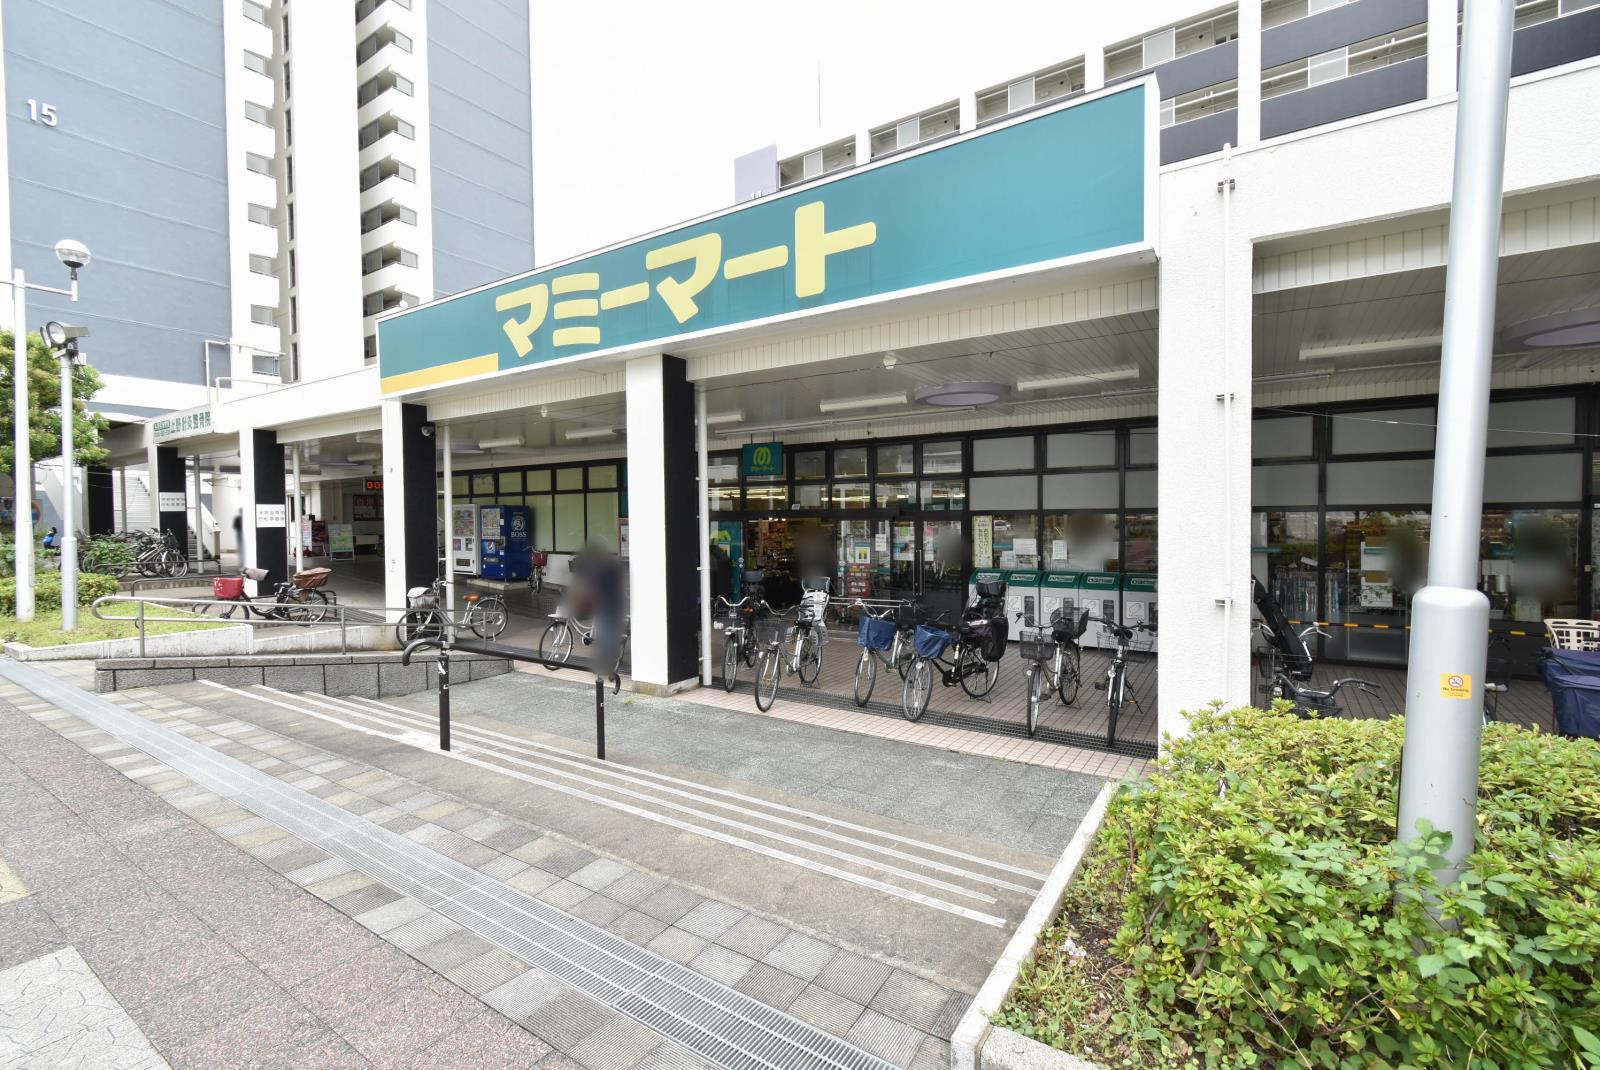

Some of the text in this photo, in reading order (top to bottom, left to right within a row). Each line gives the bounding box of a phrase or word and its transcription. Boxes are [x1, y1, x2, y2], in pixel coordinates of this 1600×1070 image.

[27, 98, 57, 127] 15
[495, 200, 877, 358] マミーマート
